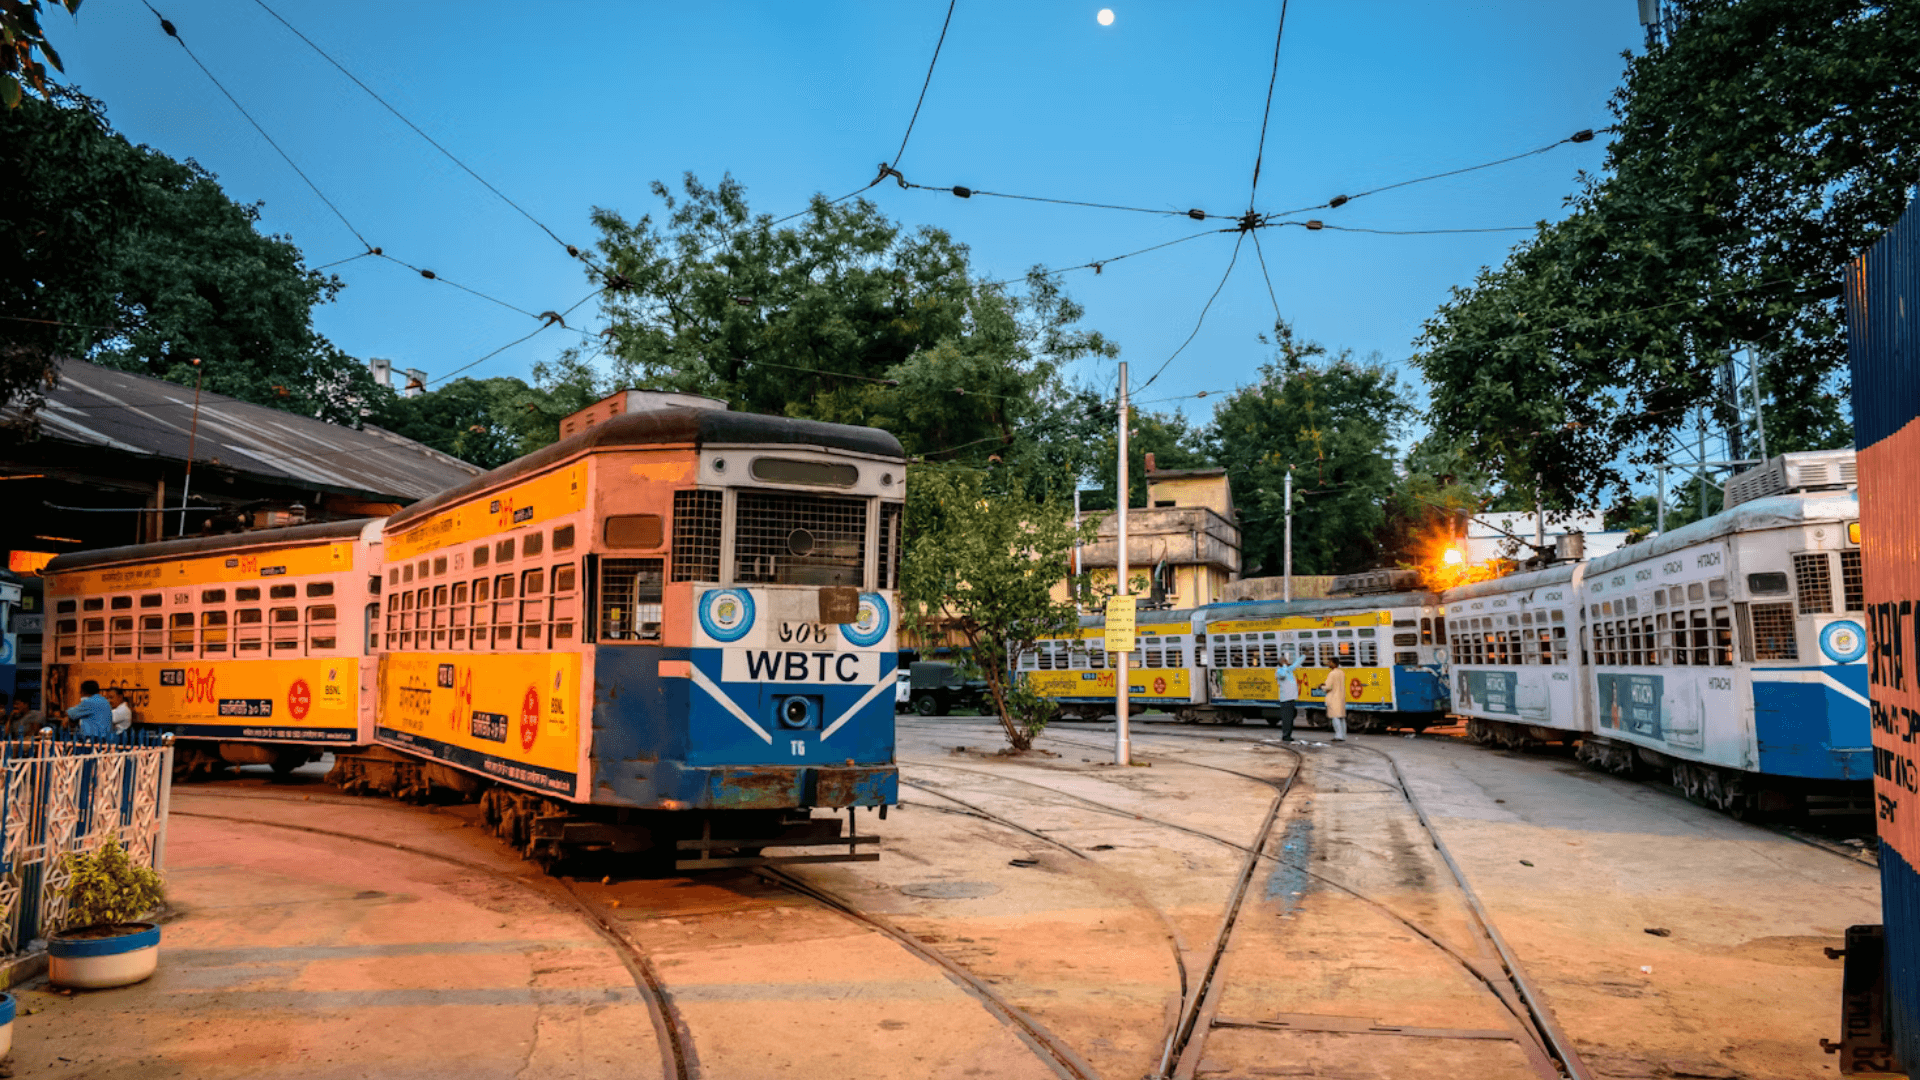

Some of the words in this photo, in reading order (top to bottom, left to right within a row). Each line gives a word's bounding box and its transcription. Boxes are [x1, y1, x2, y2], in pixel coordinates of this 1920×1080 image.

[1663, 560, 1683, 576] HITACHI
[1697, 551, 1721, 569] HITACHI
[746, 651, 859, 682] WBTC
[1708, 677, 1731, 690] HITACHI
